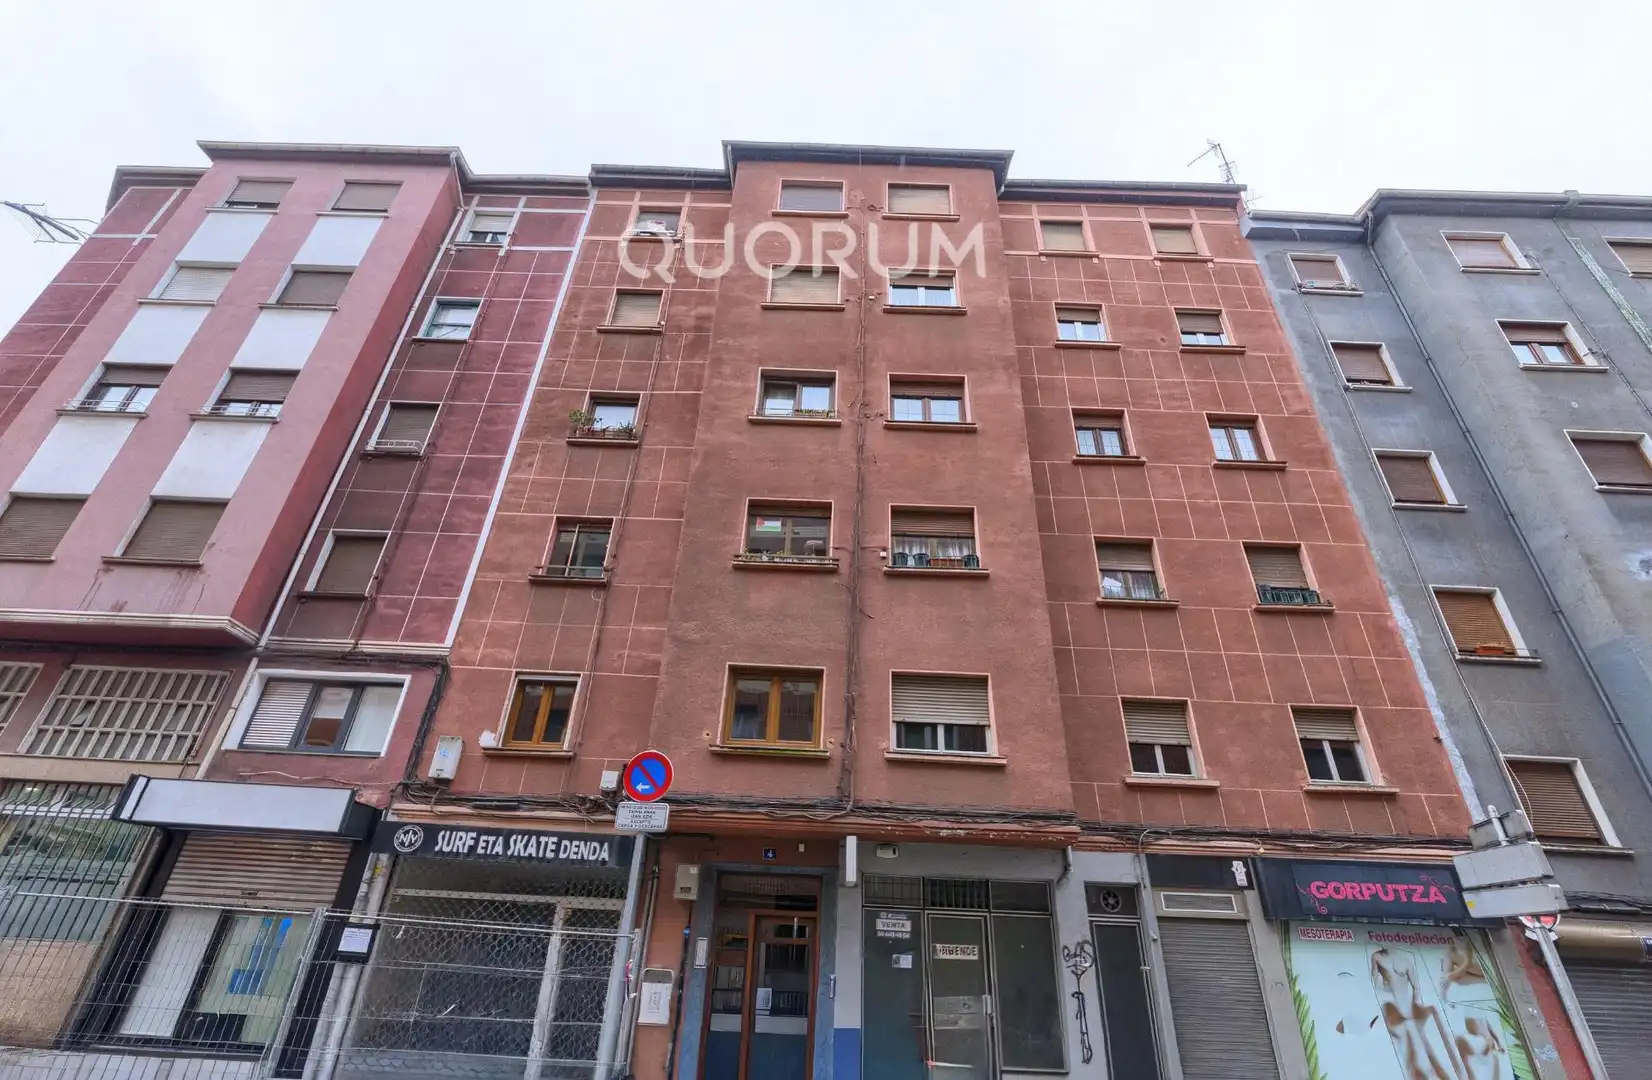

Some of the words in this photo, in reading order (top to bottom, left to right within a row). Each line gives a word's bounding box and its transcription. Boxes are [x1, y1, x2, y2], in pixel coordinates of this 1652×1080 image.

[435, 830, 477, 853] SURF
[476, 835, 503, 856] ETA
[507, 834, 558, 858] SKATE
[559, 840, 609, 861] DENDA
[1309, 880, 1448, 904] GORPUTZA
[1299, 927, 1354, 942] MESOTERAPIA
